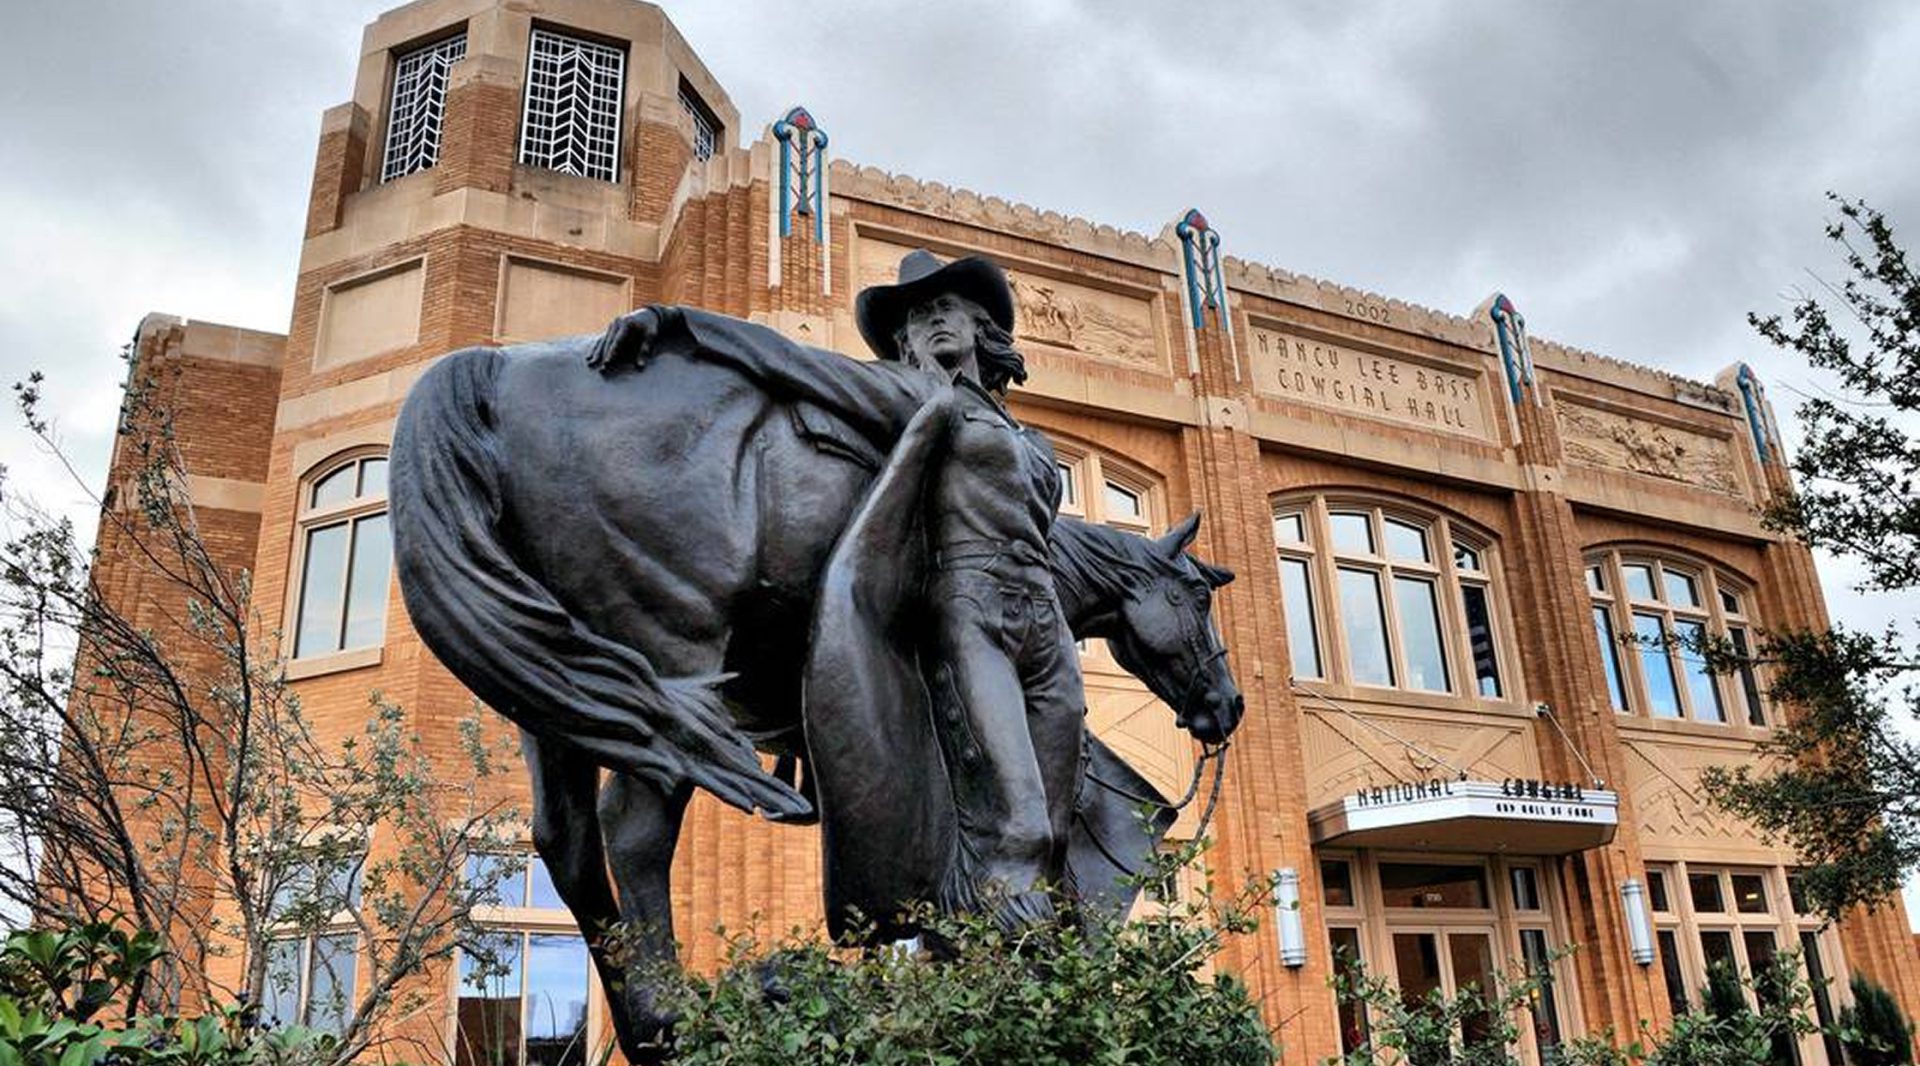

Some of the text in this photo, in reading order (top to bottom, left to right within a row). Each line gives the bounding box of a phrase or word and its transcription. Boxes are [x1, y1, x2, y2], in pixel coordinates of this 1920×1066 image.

[1345, 299, 1391, 323] 2002
[1257, 334, 1471, 400] NANCY LEE BASS
[1277, 368, 1466, 428] COWGIRL HALL
[1356, 778, 1585, 807] NATIONAL COWGIRL
